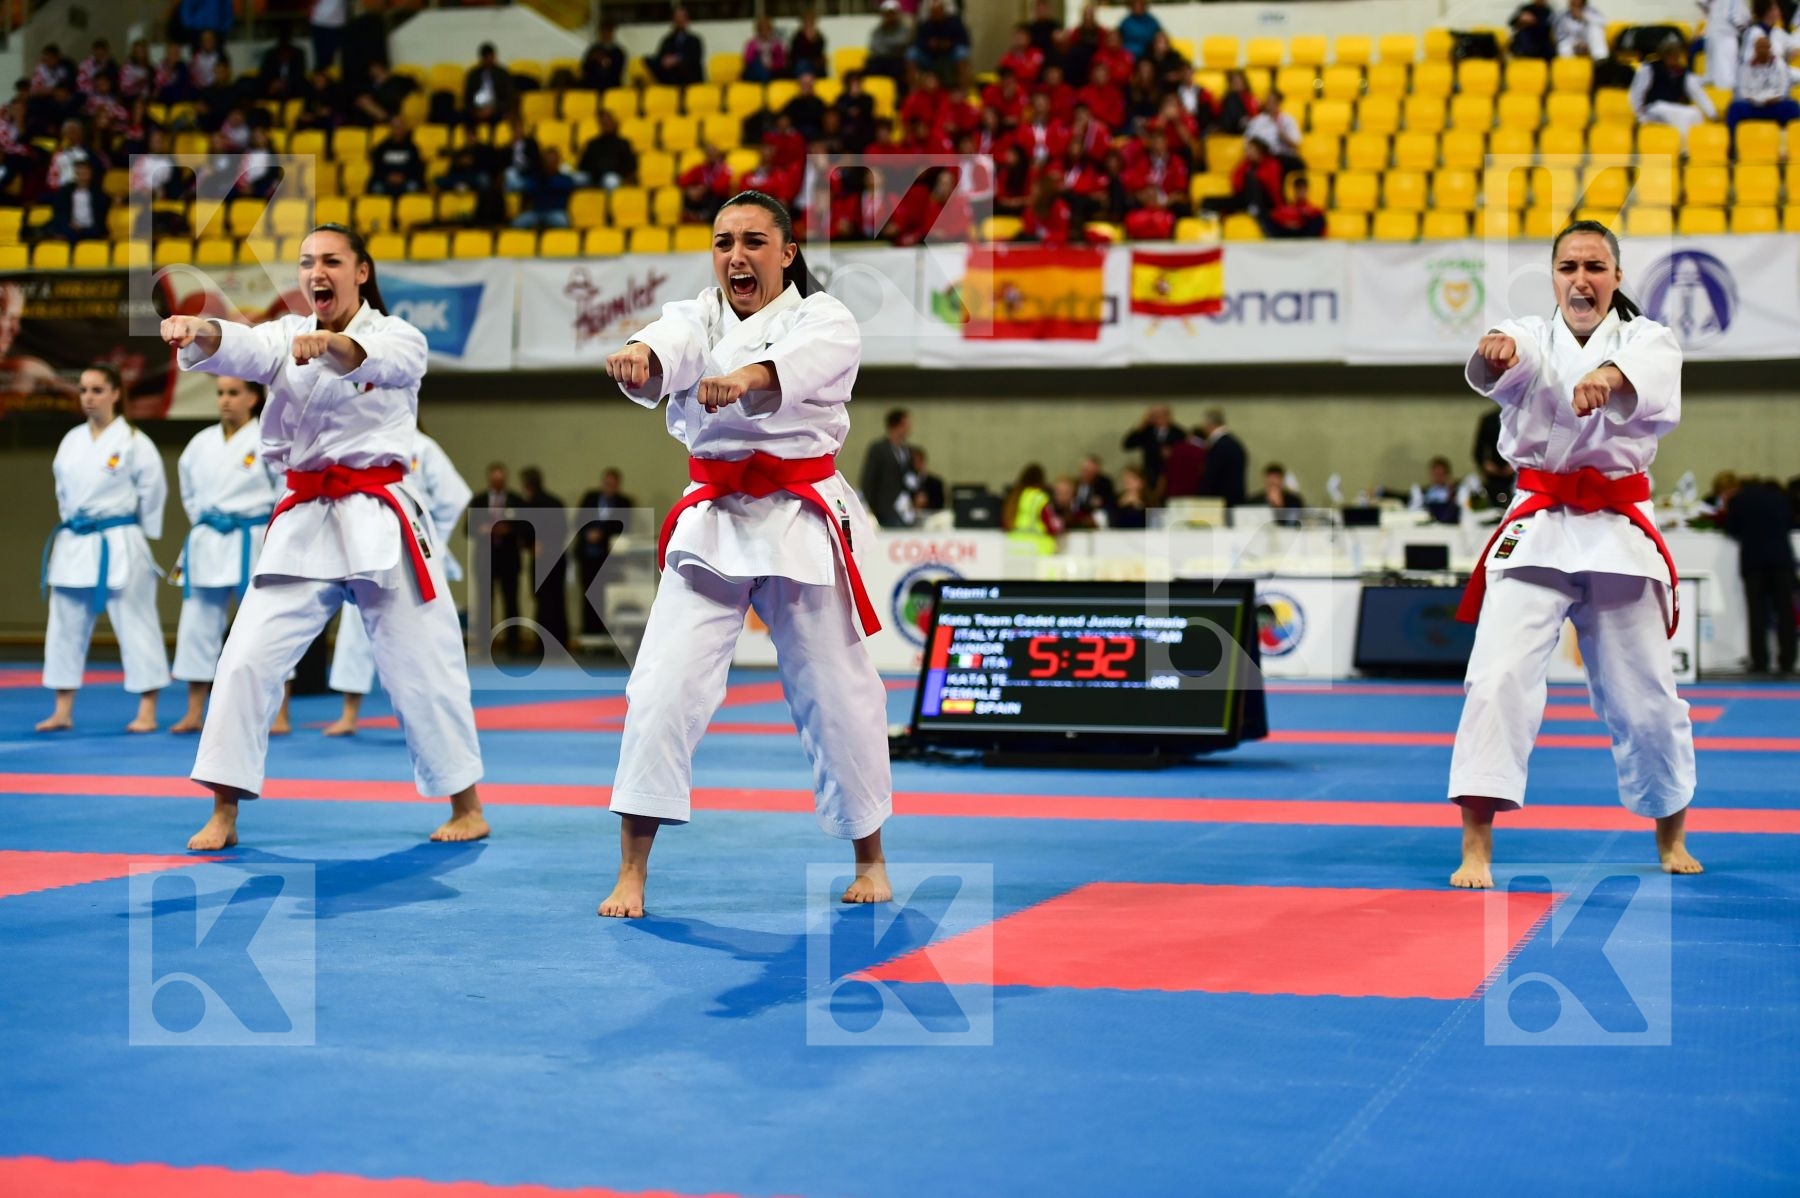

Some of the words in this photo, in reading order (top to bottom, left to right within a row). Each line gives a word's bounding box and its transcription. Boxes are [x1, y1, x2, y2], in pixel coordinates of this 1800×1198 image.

[888, 540, 977, 564] COACH
[939, 613, 972, 626] Kata
[974, 613, 1013, 626] Team
[1057, 614, 1086, 628] and
[1087, 615, 1133, 628] Junior
[1135, 615, 1188, 629] Female
[954, 628, 998, 641] ITALY
[947, 642, 1005, 655] JUNIOR
[1028, 636, 1136, 678] 5:32
[946, 673, 988, 686] KATA
[940, 687, 1001, 700] FEMALE
[975, 701, 1022, 715] SPAIN
